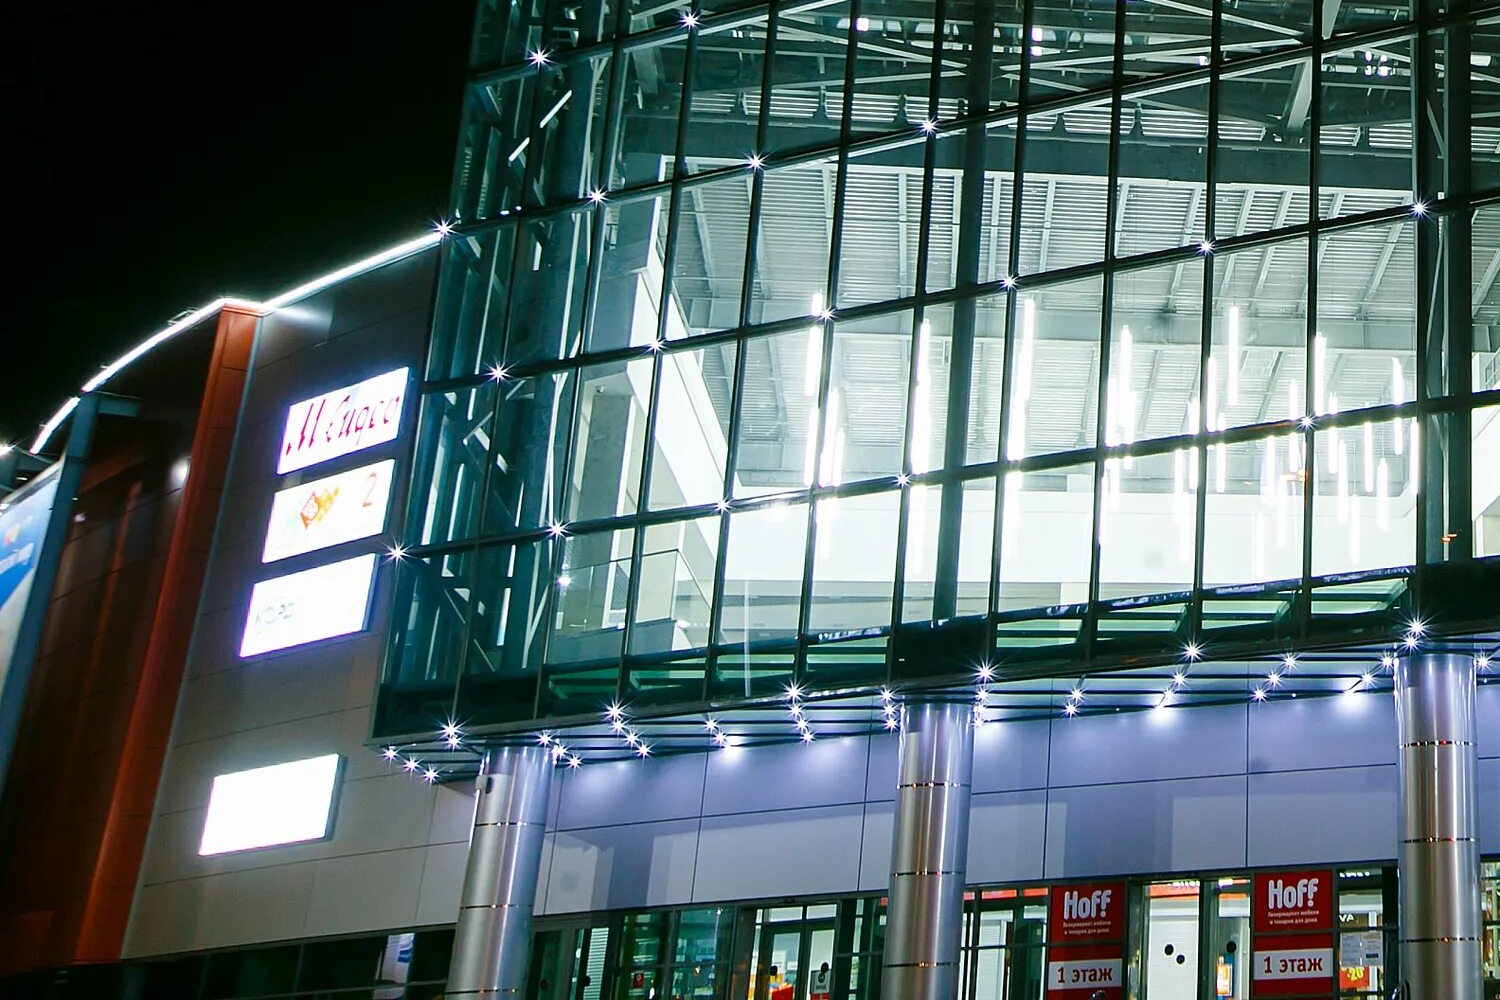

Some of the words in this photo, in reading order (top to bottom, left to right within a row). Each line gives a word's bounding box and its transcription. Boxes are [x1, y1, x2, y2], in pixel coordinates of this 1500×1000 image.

[1063, 889, 1112, 920] Hoff
[1268, 878, 1319, 909] Hoff
[1057, 967, 1065, 983] 1
[1072, 967, 1112, 983] этаж
[1263, 956, 1272, 974] 1
[1279, 957, 1323, 973] этаж
